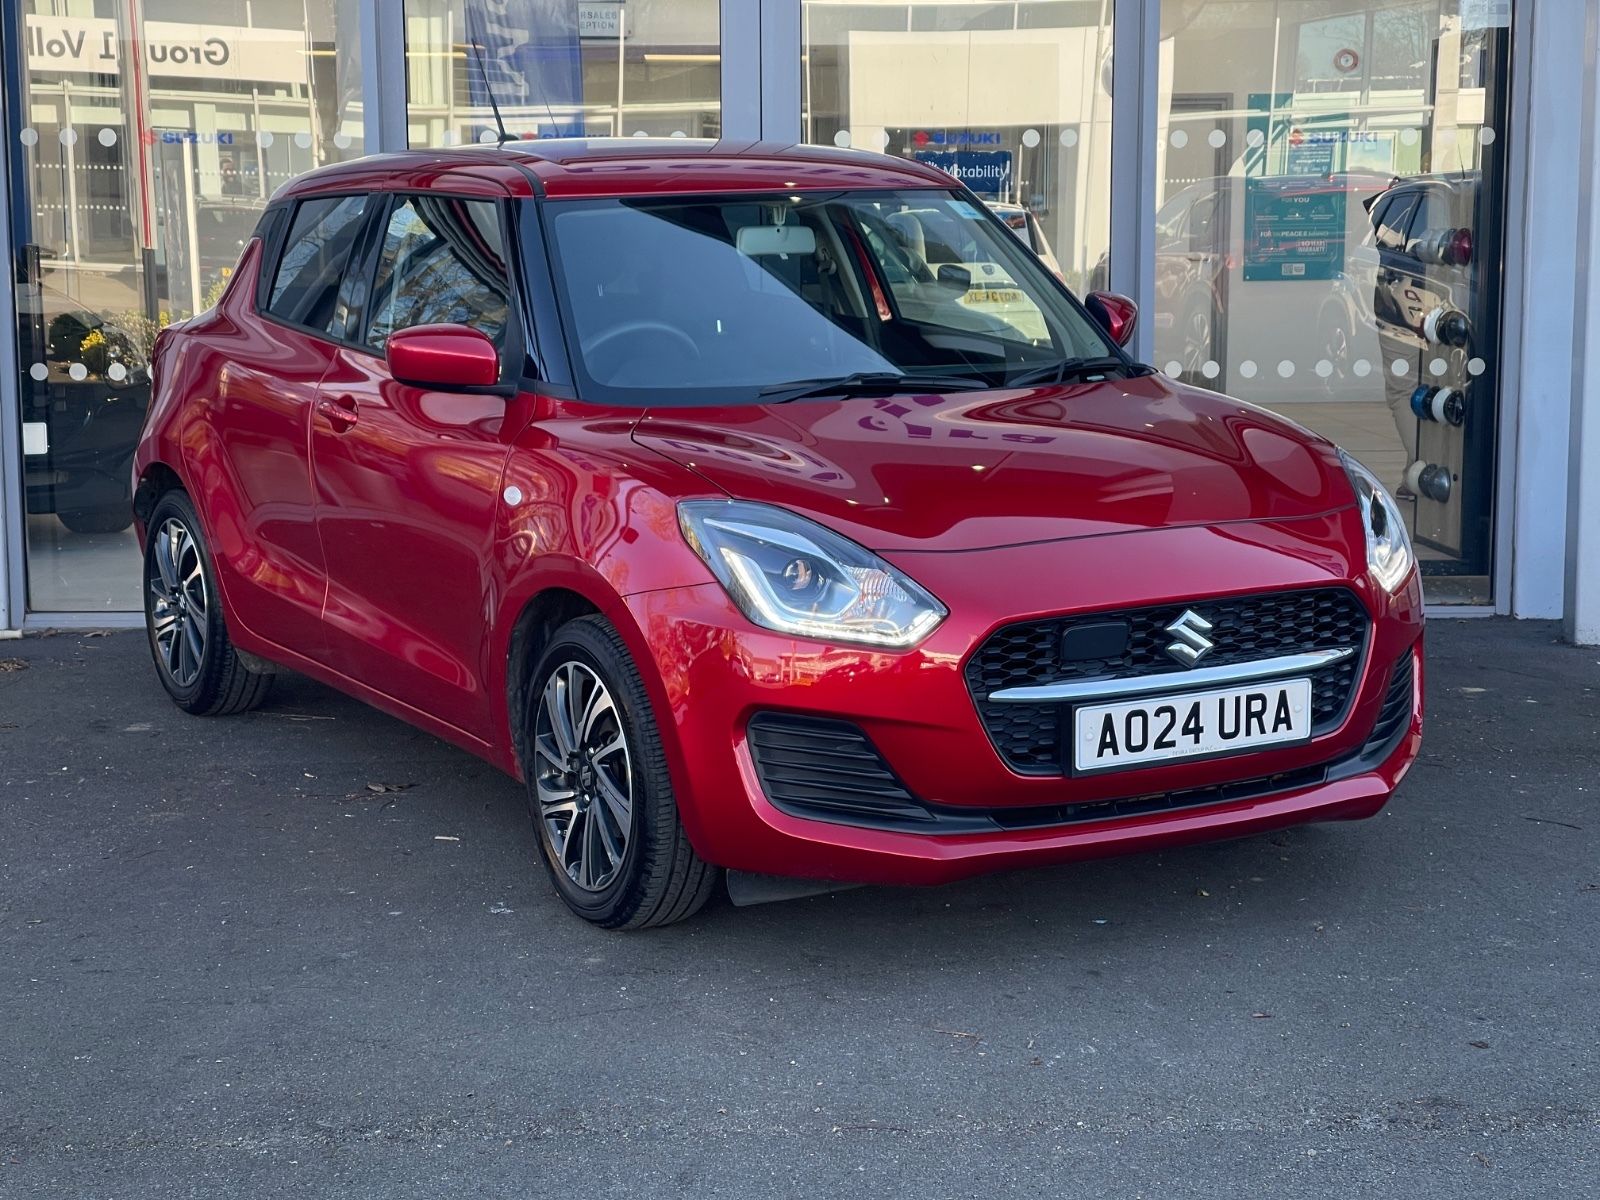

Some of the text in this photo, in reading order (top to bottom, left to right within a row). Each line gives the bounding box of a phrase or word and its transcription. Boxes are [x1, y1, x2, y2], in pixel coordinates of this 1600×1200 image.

[162, 132, 234, 144] SUZUKI
[932, 131, 1001, 145] SUZUKI
[943, 164, 1007, 180] Motability
[1218, 689, 1293, 741] URA
